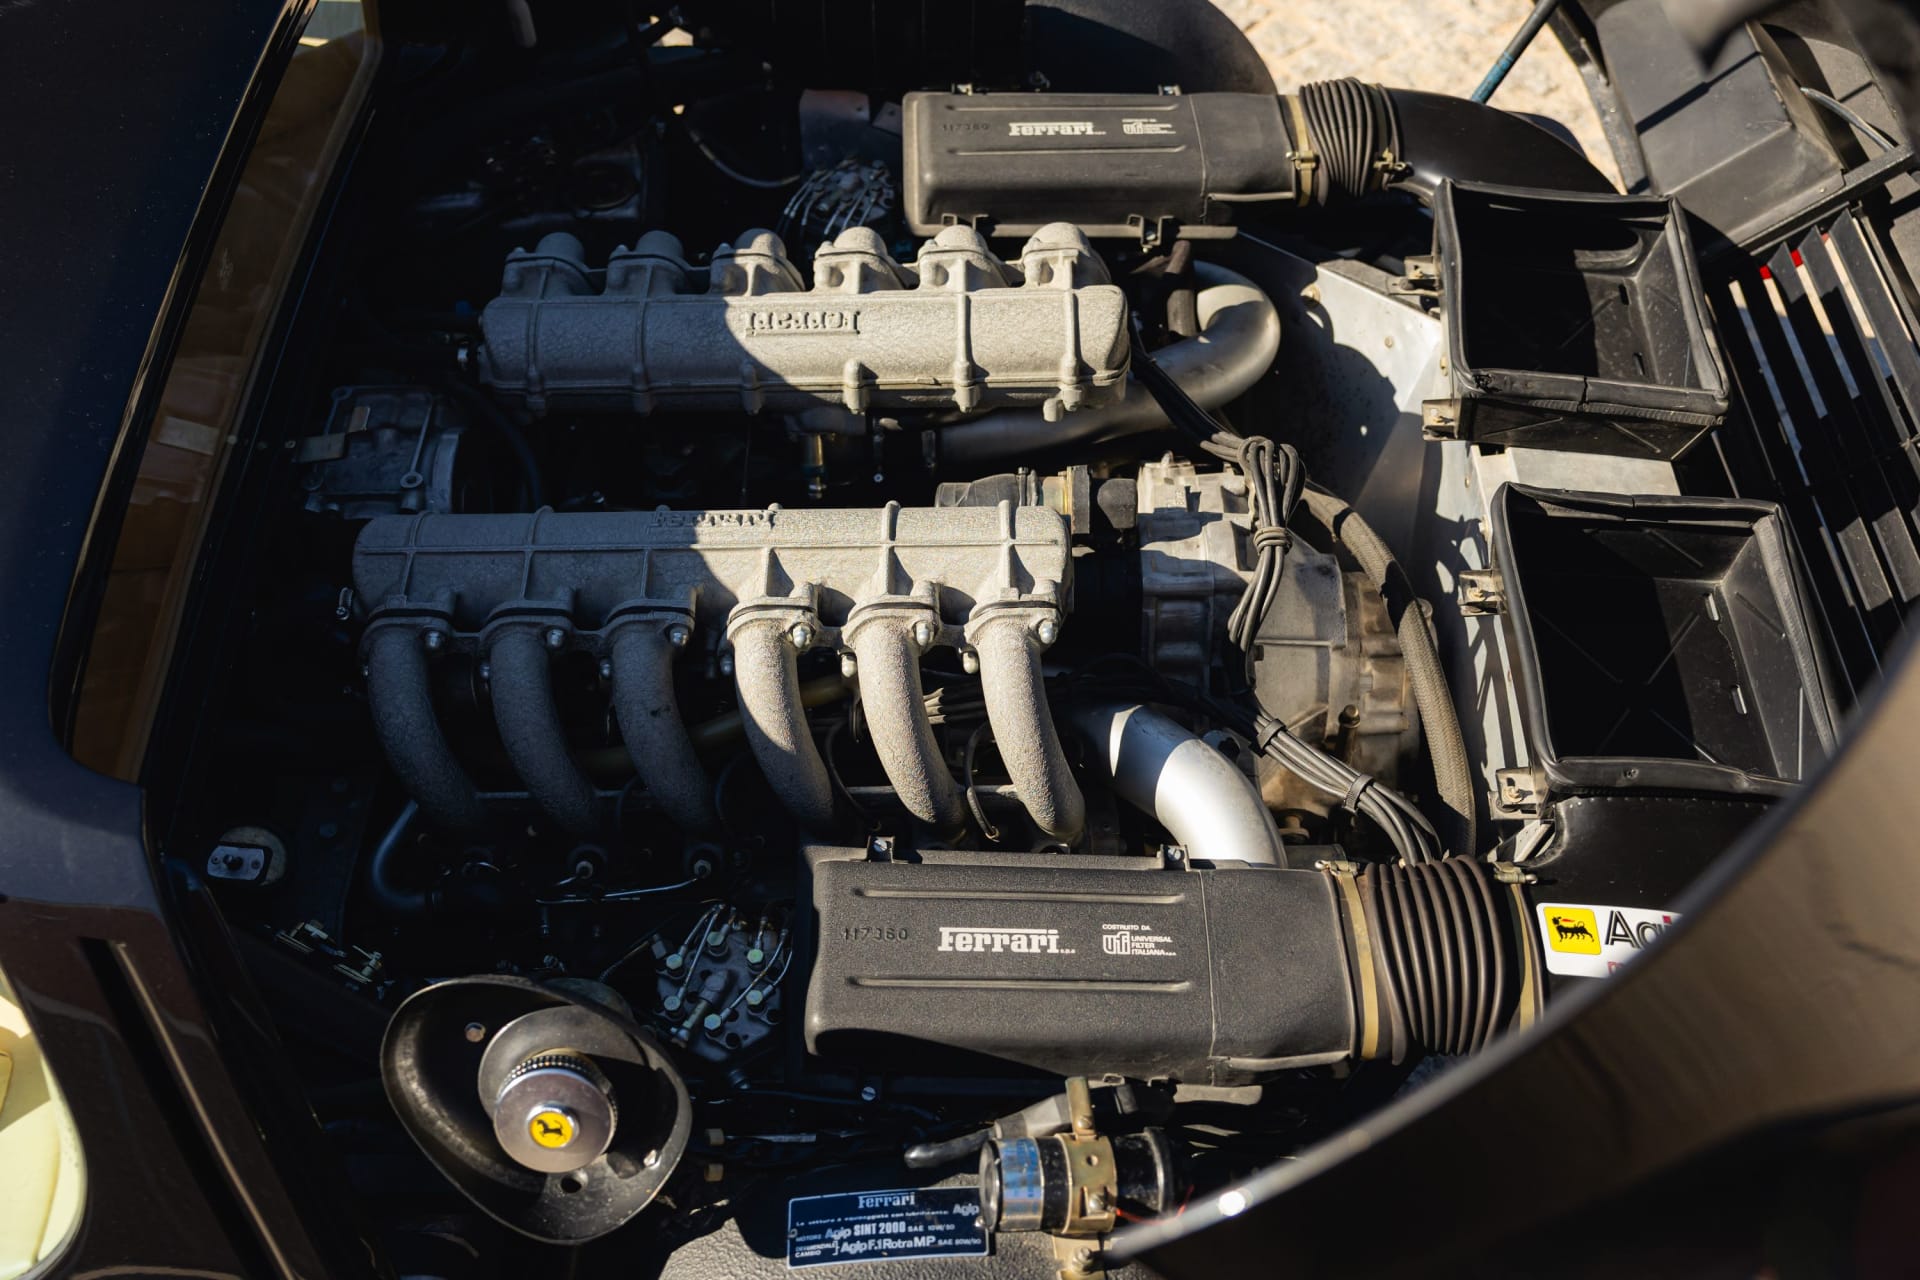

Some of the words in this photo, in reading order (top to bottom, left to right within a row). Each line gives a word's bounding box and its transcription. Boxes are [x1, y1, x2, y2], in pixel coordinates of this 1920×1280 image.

[1008, 122, 1094, 137] Ferrari
[1102, 923, 1139, 931] COSTRUITO
[937, 926, 1060, 954] Ferrari
[1131, 935, 1173, 943] UNIVERSAL
[858, 1192, 916, 1209] Ferrari
[952, 1203, 980, 1217] Agip
[825, 1226, 852, 1241] Agip
[853, 1222, 877, 1237] SINT
[878, 1220, 907, 1235] 2000
[907, 1225, 925, 1233] SAE
[795, 1249, 822, 1258] CAMBIO
[840, 1239, 867, 1255] Agip
[937, 1238, 953, 1246] SAE
